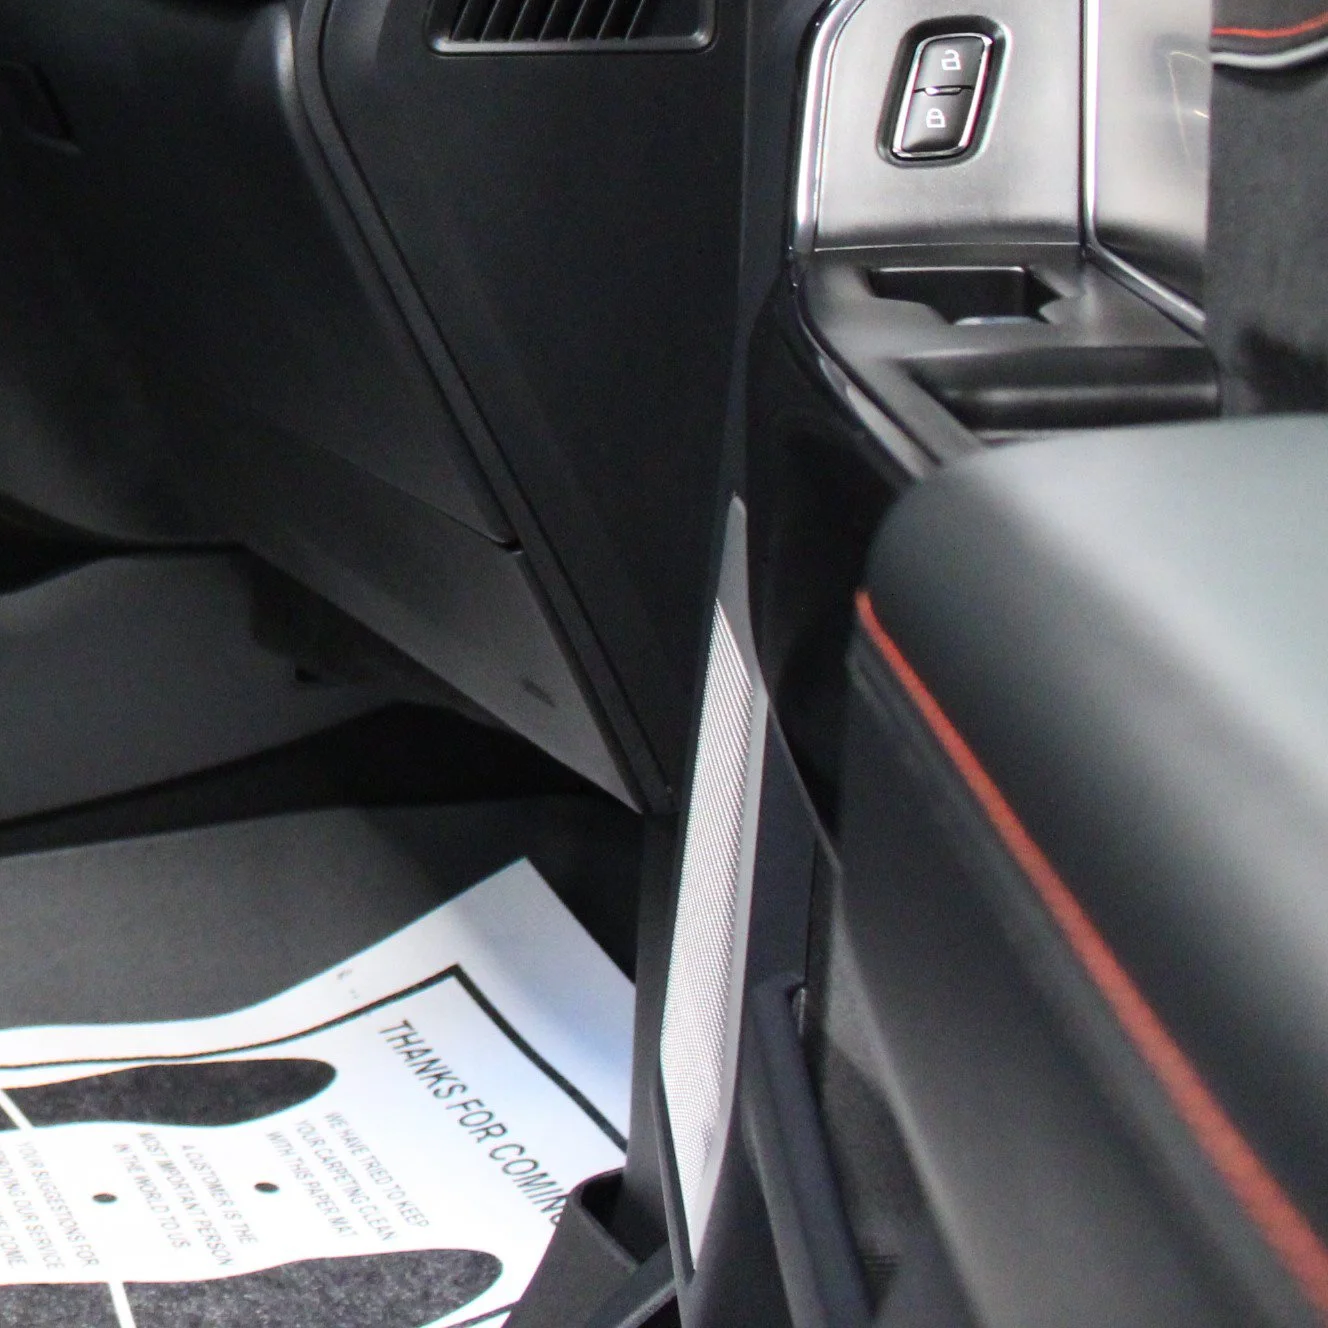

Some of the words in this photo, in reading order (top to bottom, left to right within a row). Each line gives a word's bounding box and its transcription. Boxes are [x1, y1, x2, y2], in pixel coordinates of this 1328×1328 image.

[378, 1019, 468, 1100] THANKS
[445, 1099, 508, 1144] FOR
[488, 1143, 570, 1226] COMIN
[134, 1175, 170, 1213] WORLD
[185, 1152, 235, 1207] CUSTOMER
[265, 1130, 295, 1157] WITH
[289, 1157, 315, 1181] THIS
[304, 1180, 340, 1216] PAPER
[327, 1215, 359, 1238] MAT
[295, 1119, 326, 1148] YOUR
[314, 1147, 370, 1205] CARPETING
[358, 1205, 398, 1241] CLEAN
[324, 1112, 348, 1129] WE
[339, 1128, 370, 1156] HAVE
[359, 1155, 394, 1186] TRIED
[383, 1184, 406, 1201] TO
[395, 1200, 430, 1228] KEEP
[17, 1141, 45, 1168] YOUR
[72, 1244, 100, 1268] FOR
[137, 1132, 169, 1156] MOST
[156, 1160, 208, 1217] IMPORTANT
[193, 1219, 235, 1266] PERSON
[157, 1215, 181, 1231] TO
[221, 1210, 243, 1220] IS
[25, 1224, 66, 1270] SERVICE
[166, 1232, 192, 1249] US
[230, 1222, 259, 1244] THE
